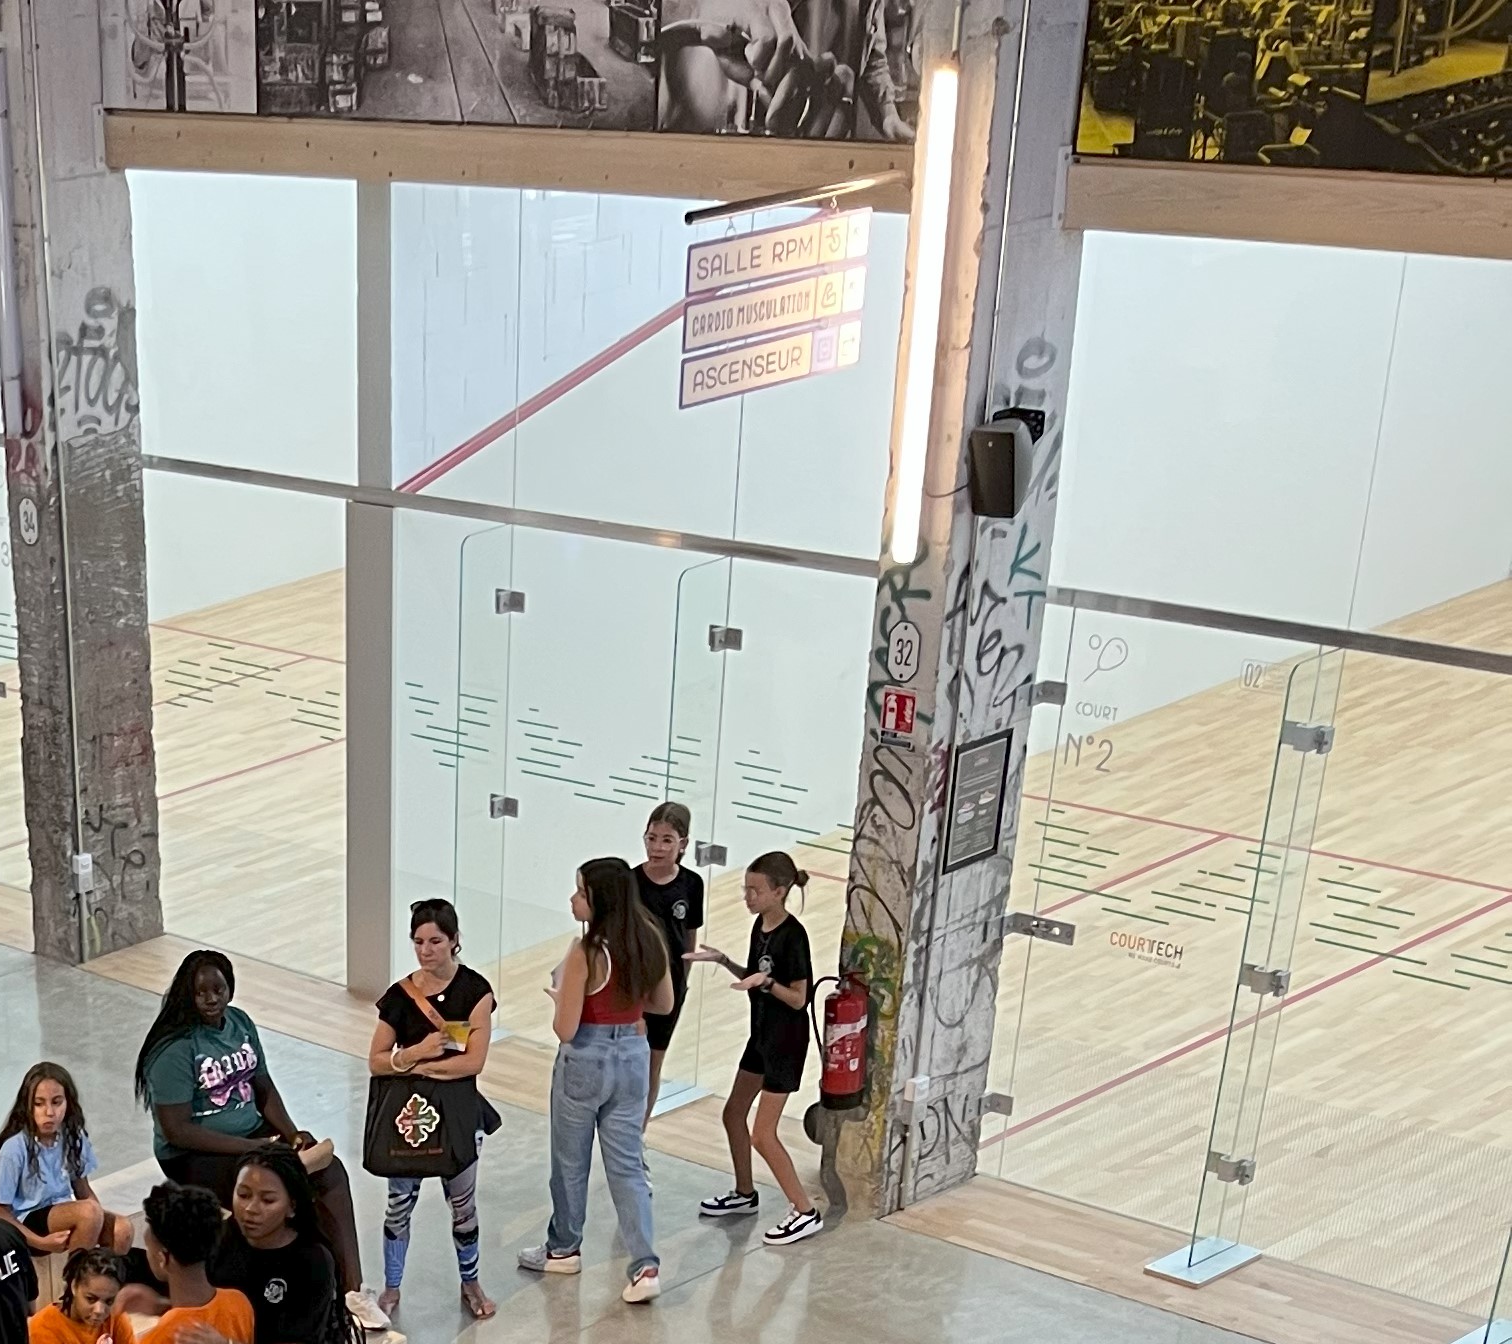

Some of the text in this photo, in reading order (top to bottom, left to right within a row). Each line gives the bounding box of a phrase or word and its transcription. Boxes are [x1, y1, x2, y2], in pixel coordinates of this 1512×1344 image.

[696, 234, 814, 281] SALLE RPM
[692, 290, 811, 337] CARDIO MUSCULATION
[692, 345, 803, 393] ASCENSEUR
[894, 638, 913, 667] 32
[1075, 700, 1119, 721] COURT
[1063, 732, 1114, 773] N°2
